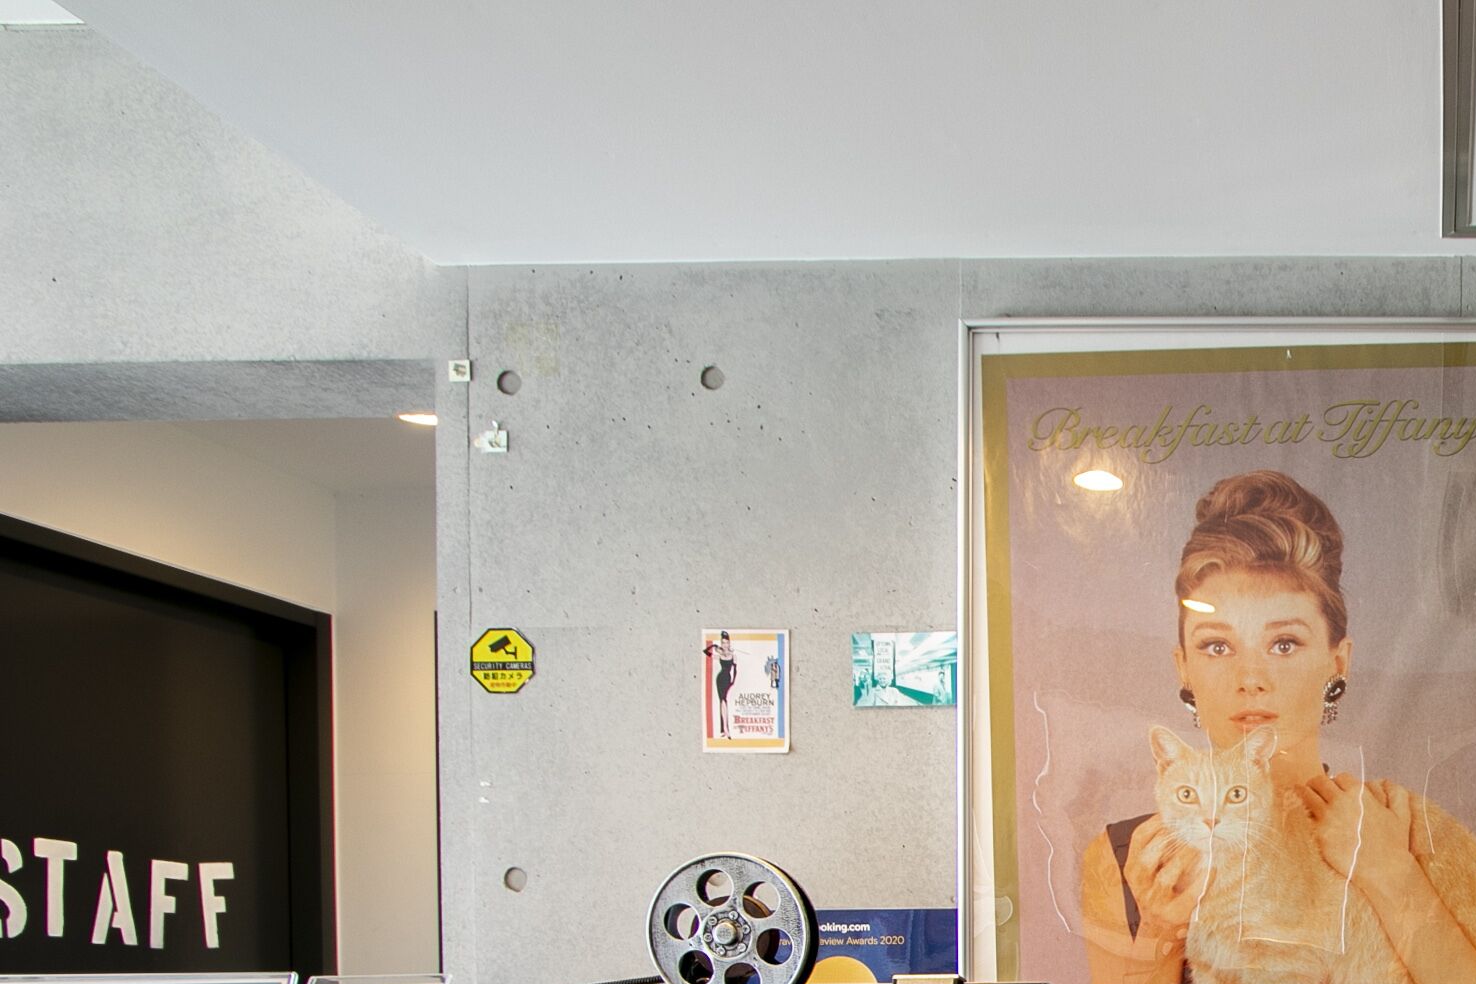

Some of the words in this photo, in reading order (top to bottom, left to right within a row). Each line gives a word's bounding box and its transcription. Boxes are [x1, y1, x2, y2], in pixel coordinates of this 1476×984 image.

[1027, 404, 1262, 464] Breakfast
[1264, 413, 1314, 445] at
[473, 662, 503, 670] SECURITY
[505, 662, 532, 670] CAMERAS
[819, 923, 871, 934] oking.com
[820, 937, 844, 946] eview
[846, 937, 879, 945] Awards
[879, 935, 905, 945] 2020
